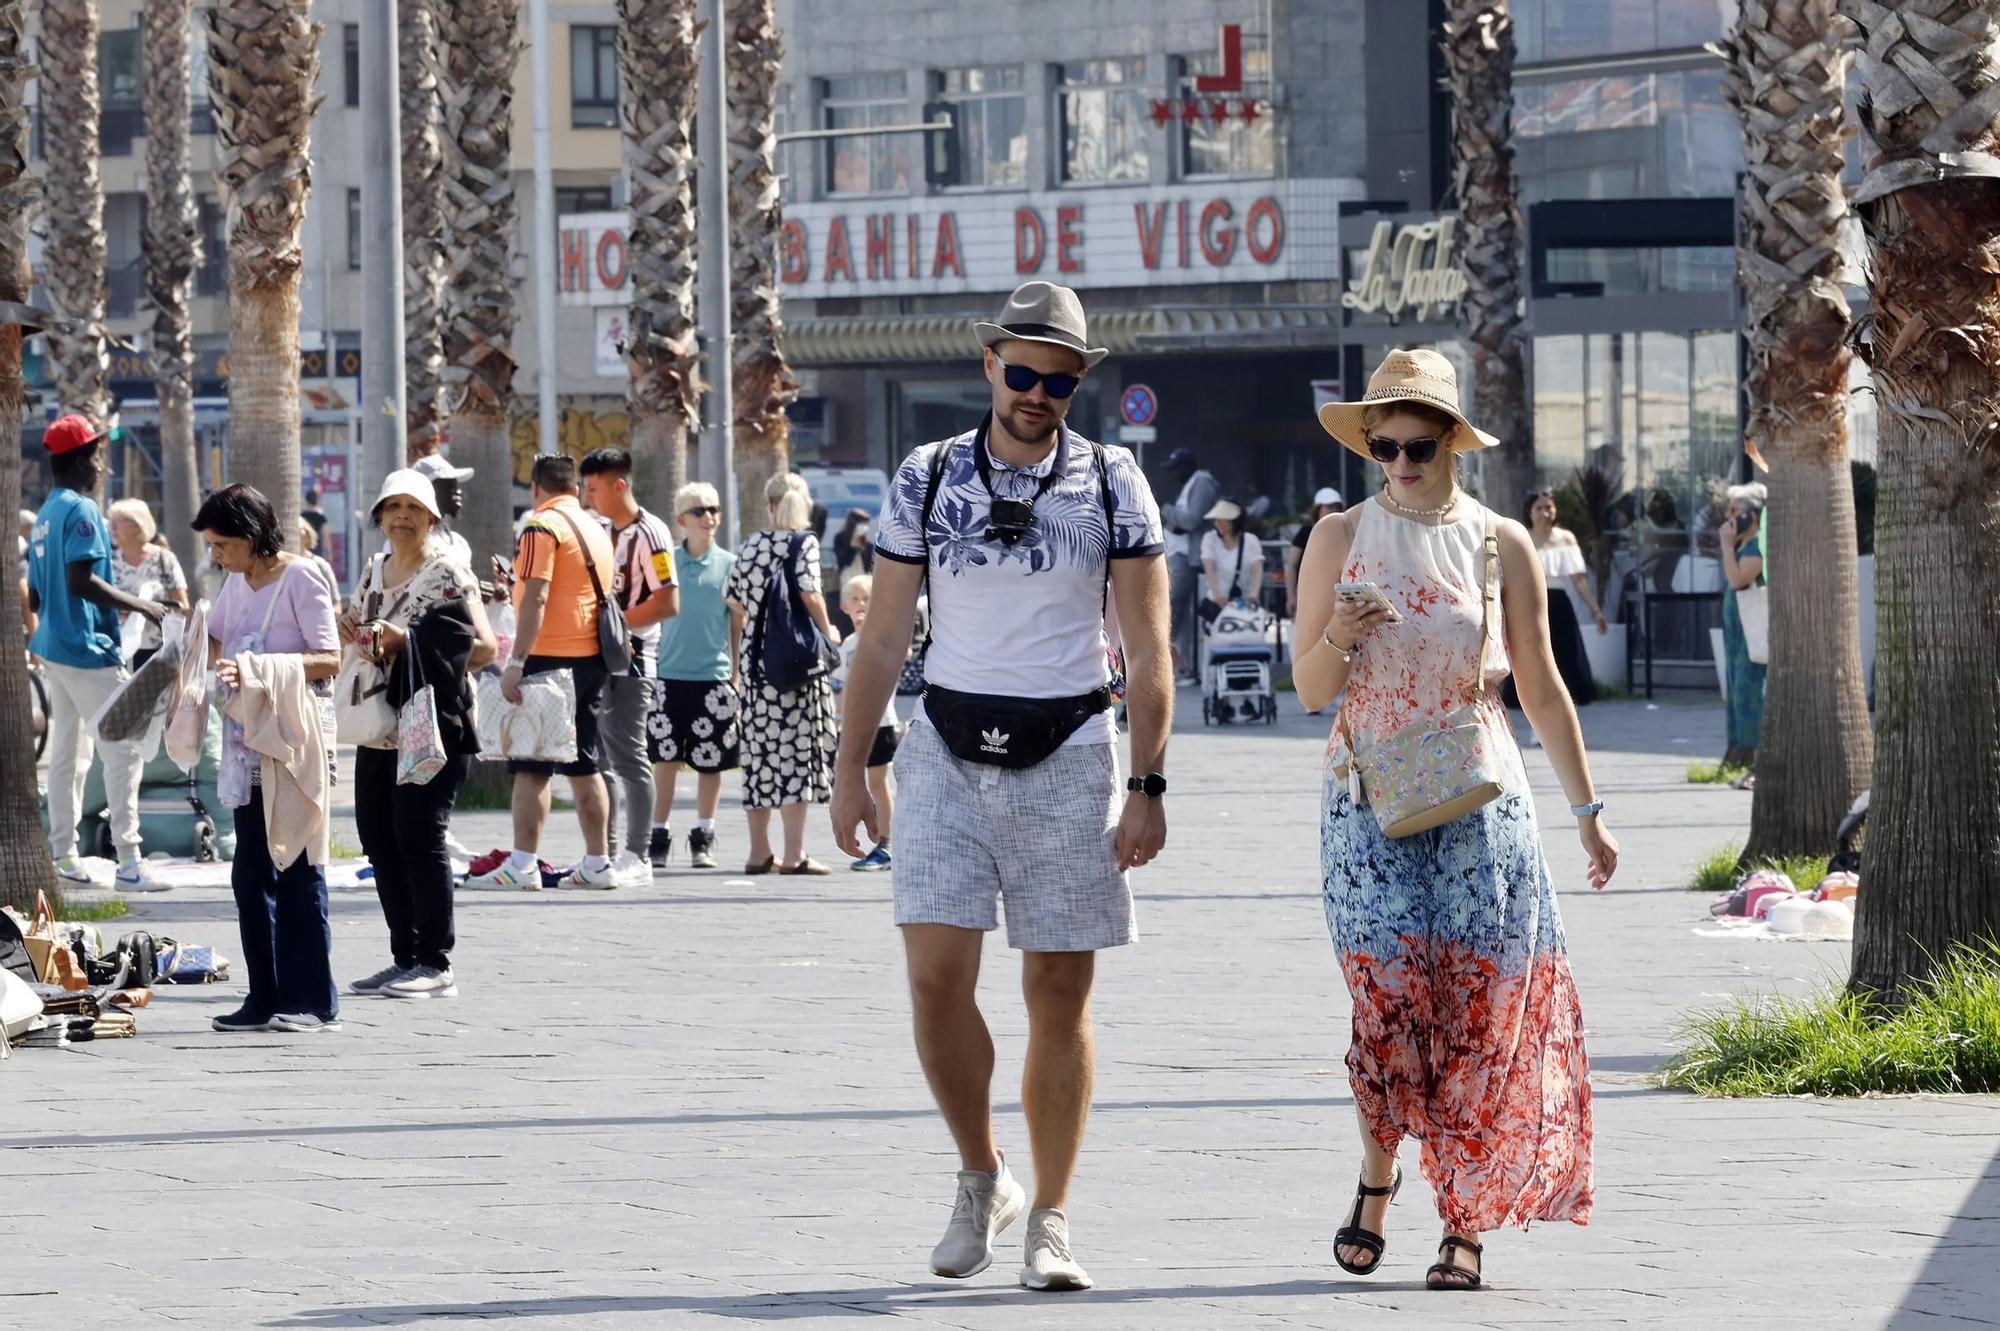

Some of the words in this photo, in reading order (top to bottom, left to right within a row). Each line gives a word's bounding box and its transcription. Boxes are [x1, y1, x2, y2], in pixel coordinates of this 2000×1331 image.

[781, 211, 966, 284] BAHIA
[1014, 205, 1083, 275] DE
[1133, 196, 1285, 269] VIGO
[980, 744, 1008, 754] adidas
